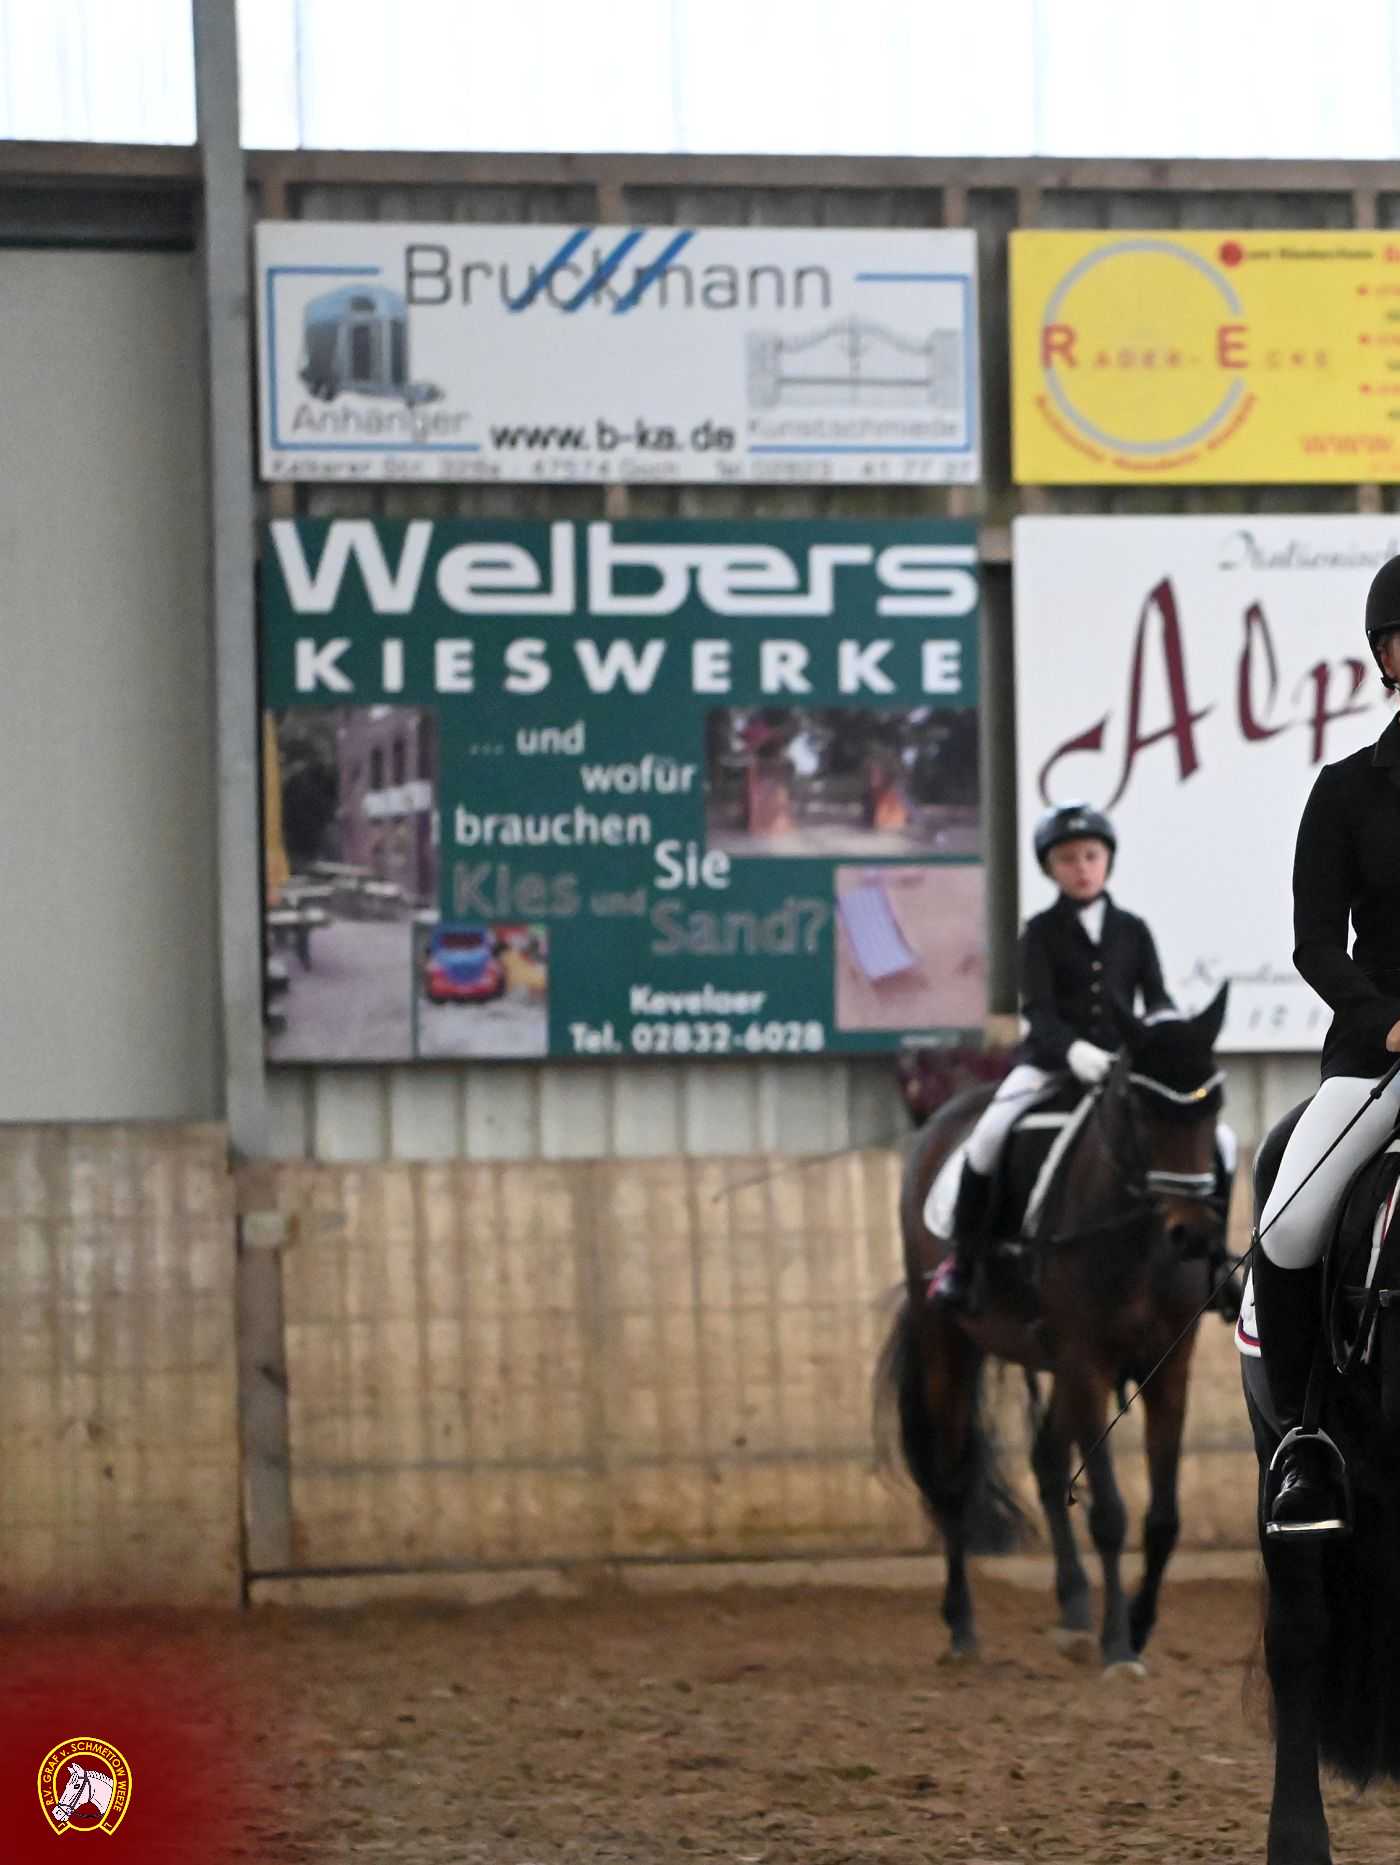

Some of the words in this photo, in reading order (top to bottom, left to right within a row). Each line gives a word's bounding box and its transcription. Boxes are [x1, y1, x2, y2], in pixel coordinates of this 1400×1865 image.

[404, 243, 832, 309] Bruckmann
[270, 518, 980, 615] Welbers
[294, 638, 964, 694] KIESWERKE
[516, 720, 586, 755] und
[580, 753, 698, 794] wofür
[454, 804, 652, 847] brauchen
[653, 838, 732, 891] Sie
[453, 862, 580, 917] Kies
[590, 886, 649, 916] und
[650, 895, 830, 957] Sand?
[628, 983, 768, 1015] Kevelaer
[569, 1020, 623, 1053] Tel.
